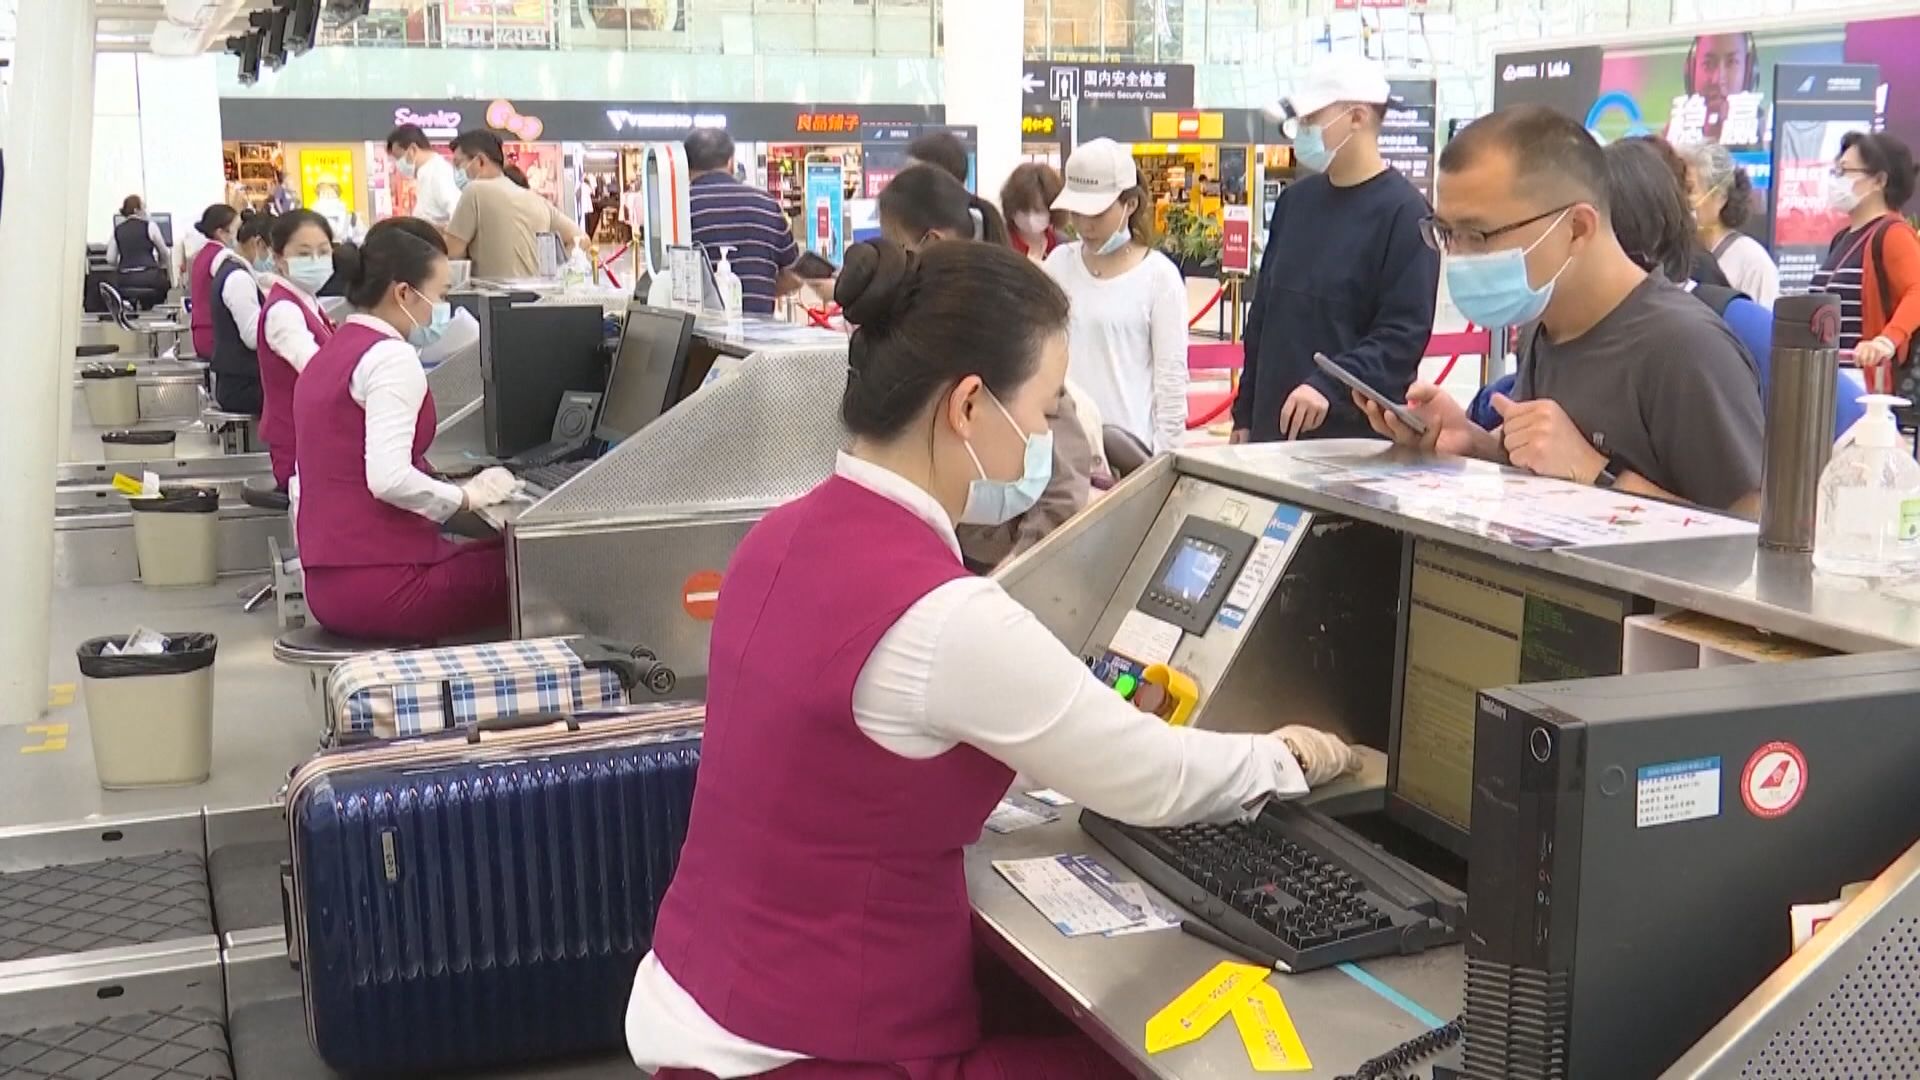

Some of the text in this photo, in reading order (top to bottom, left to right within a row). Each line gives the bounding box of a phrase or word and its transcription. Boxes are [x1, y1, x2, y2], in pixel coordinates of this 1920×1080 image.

[1084, 69, 1167, 88] 国内安全检查
[1117, 90, 1144, 100] Security
[1145, 90, 1167, 99] Check
[797, 113, 859, 132] 良品铺子
